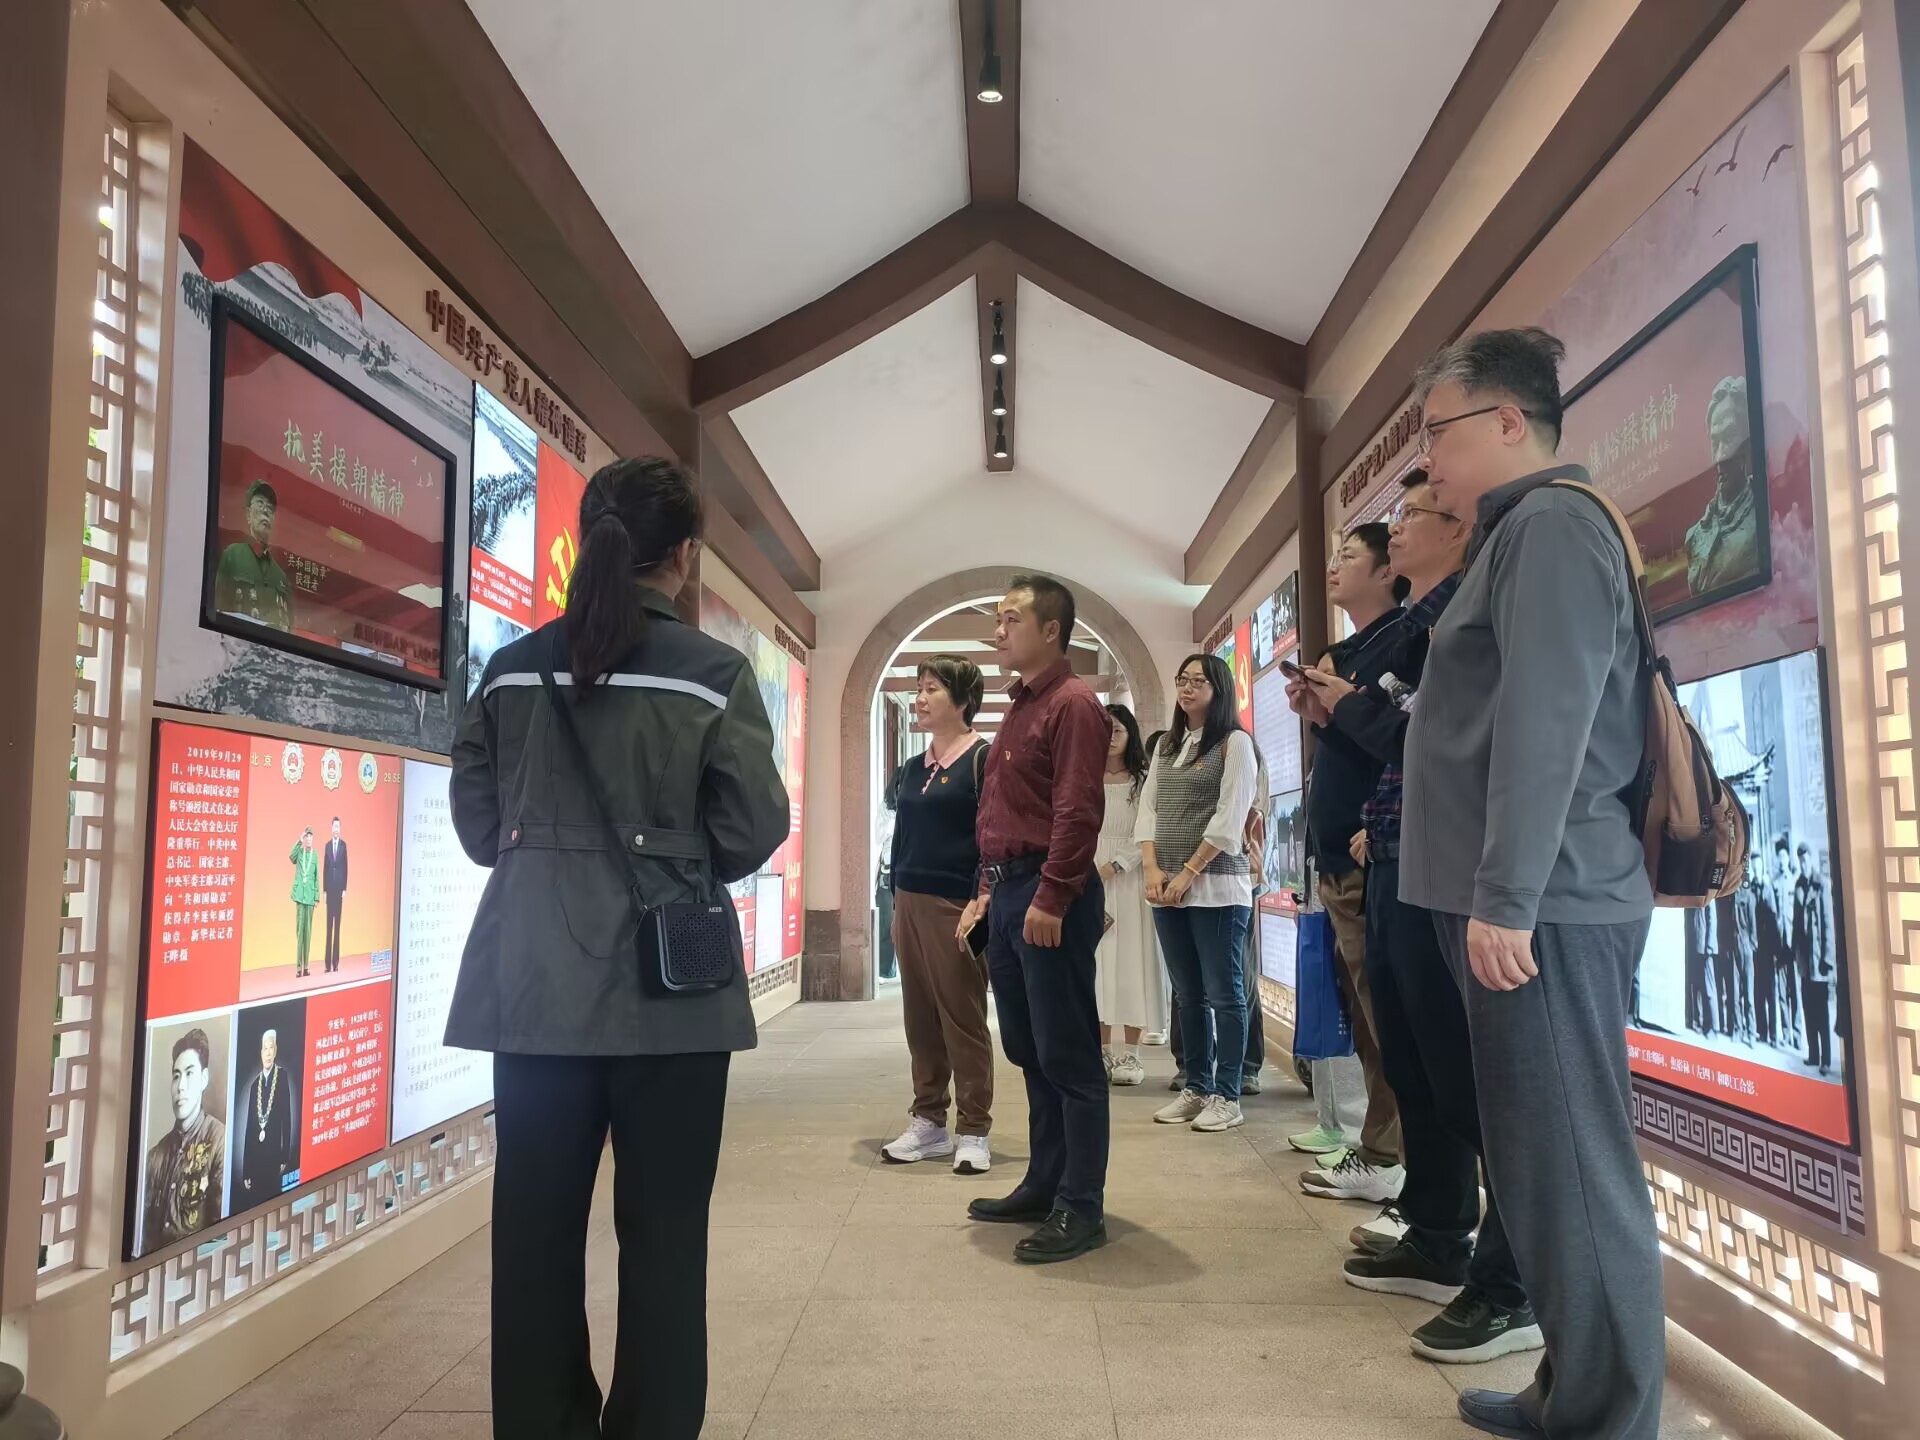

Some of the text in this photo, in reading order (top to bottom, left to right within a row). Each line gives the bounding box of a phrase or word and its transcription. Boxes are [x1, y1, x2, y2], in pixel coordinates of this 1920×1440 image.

[425, 289, 587, 463] 中国共产党人精神谱系
[283, 418, 405, 518] 抗美援朝精神
[295, 567, 319, 590] 获得者
[187, 746, 242, 763] 2019年9月29
[250, 751, 273, 767] 北京
[170, 781, 240, 799] 国家勋章和国家荣誉
[169, 799, 239, 817] 称号颁授仪式在北京
[168, 818, 238, 835] 人民大会堂金色大厅
[165, 873, 236, 888] 中央军委主席习近平
[163, 908, 234, 926] 获得者李延年颁授
